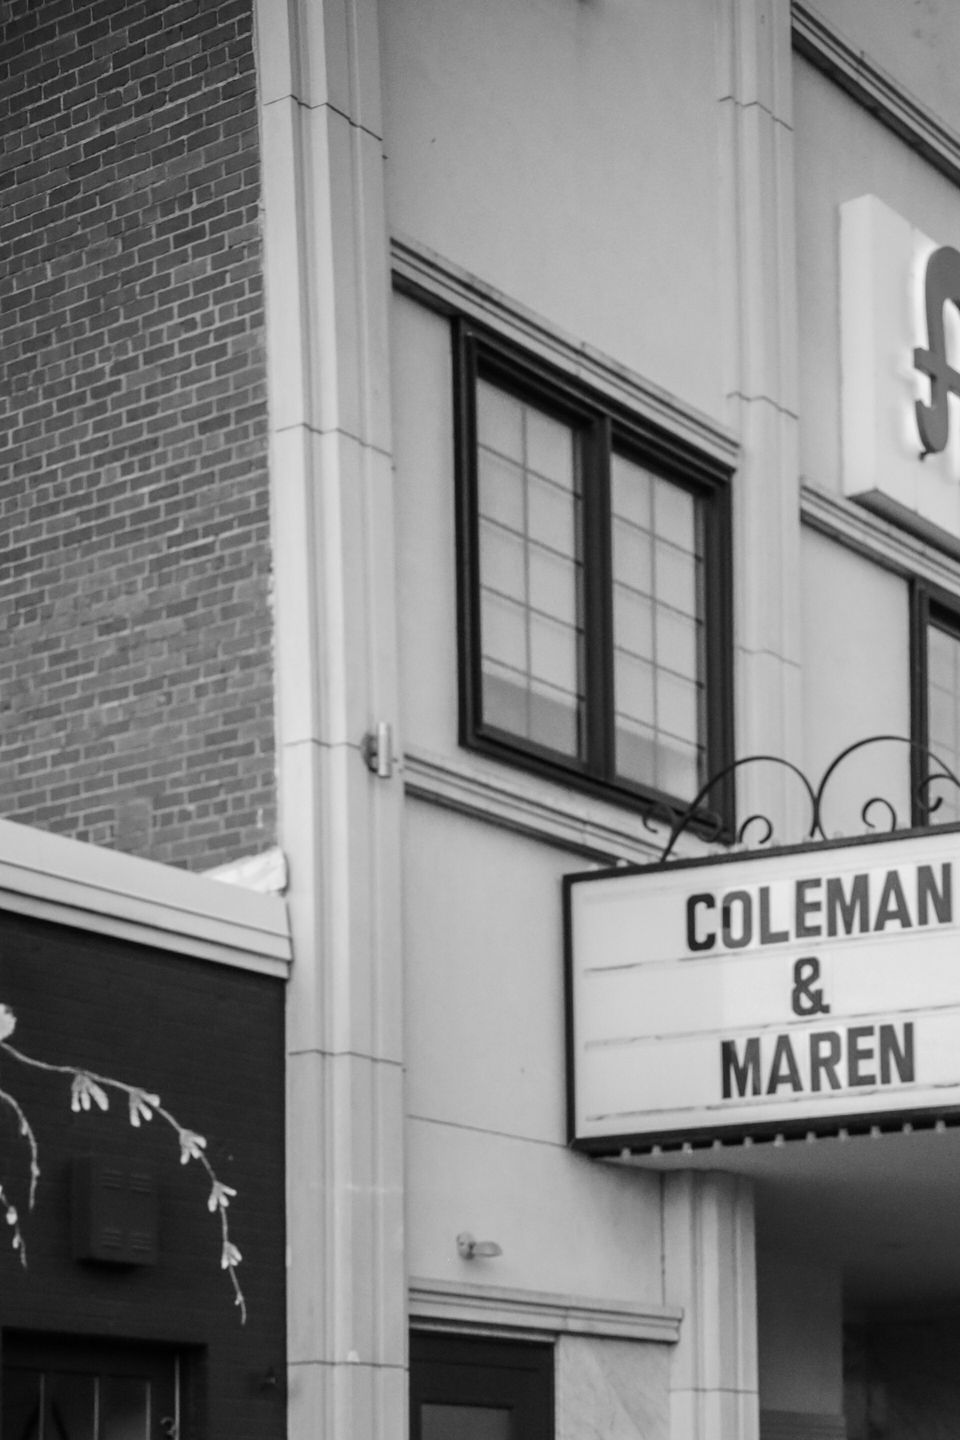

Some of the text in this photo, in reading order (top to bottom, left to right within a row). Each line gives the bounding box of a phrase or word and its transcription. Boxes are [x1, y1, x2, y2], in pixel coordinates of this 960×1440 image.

[686, 862, 953, 952] COLEMAN
[791, 956, 831, 1016] &
[721, 1022, 916, 1100] MAREN
